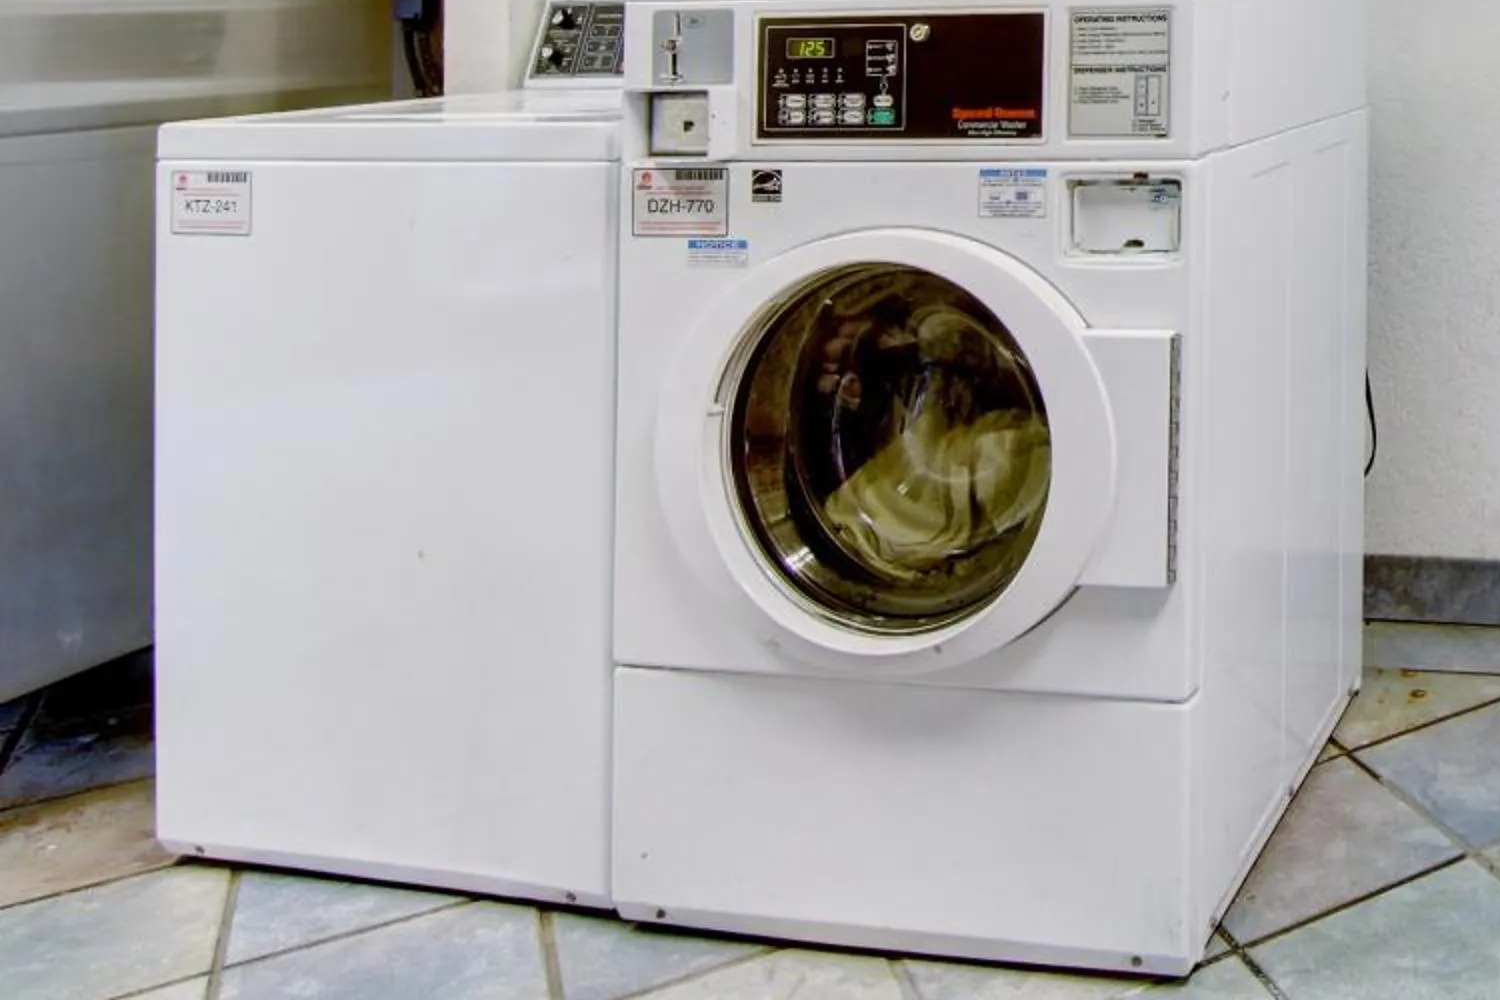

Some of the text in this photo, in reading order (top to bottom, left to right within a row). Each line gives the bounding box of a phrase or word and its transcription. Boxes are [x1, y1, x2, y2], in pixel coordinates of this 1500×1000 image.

[799, 41, 826, 57] 125
[185, 199, 238, 213] KTZ-241
[647, 198, 715, 214] DZH-770
